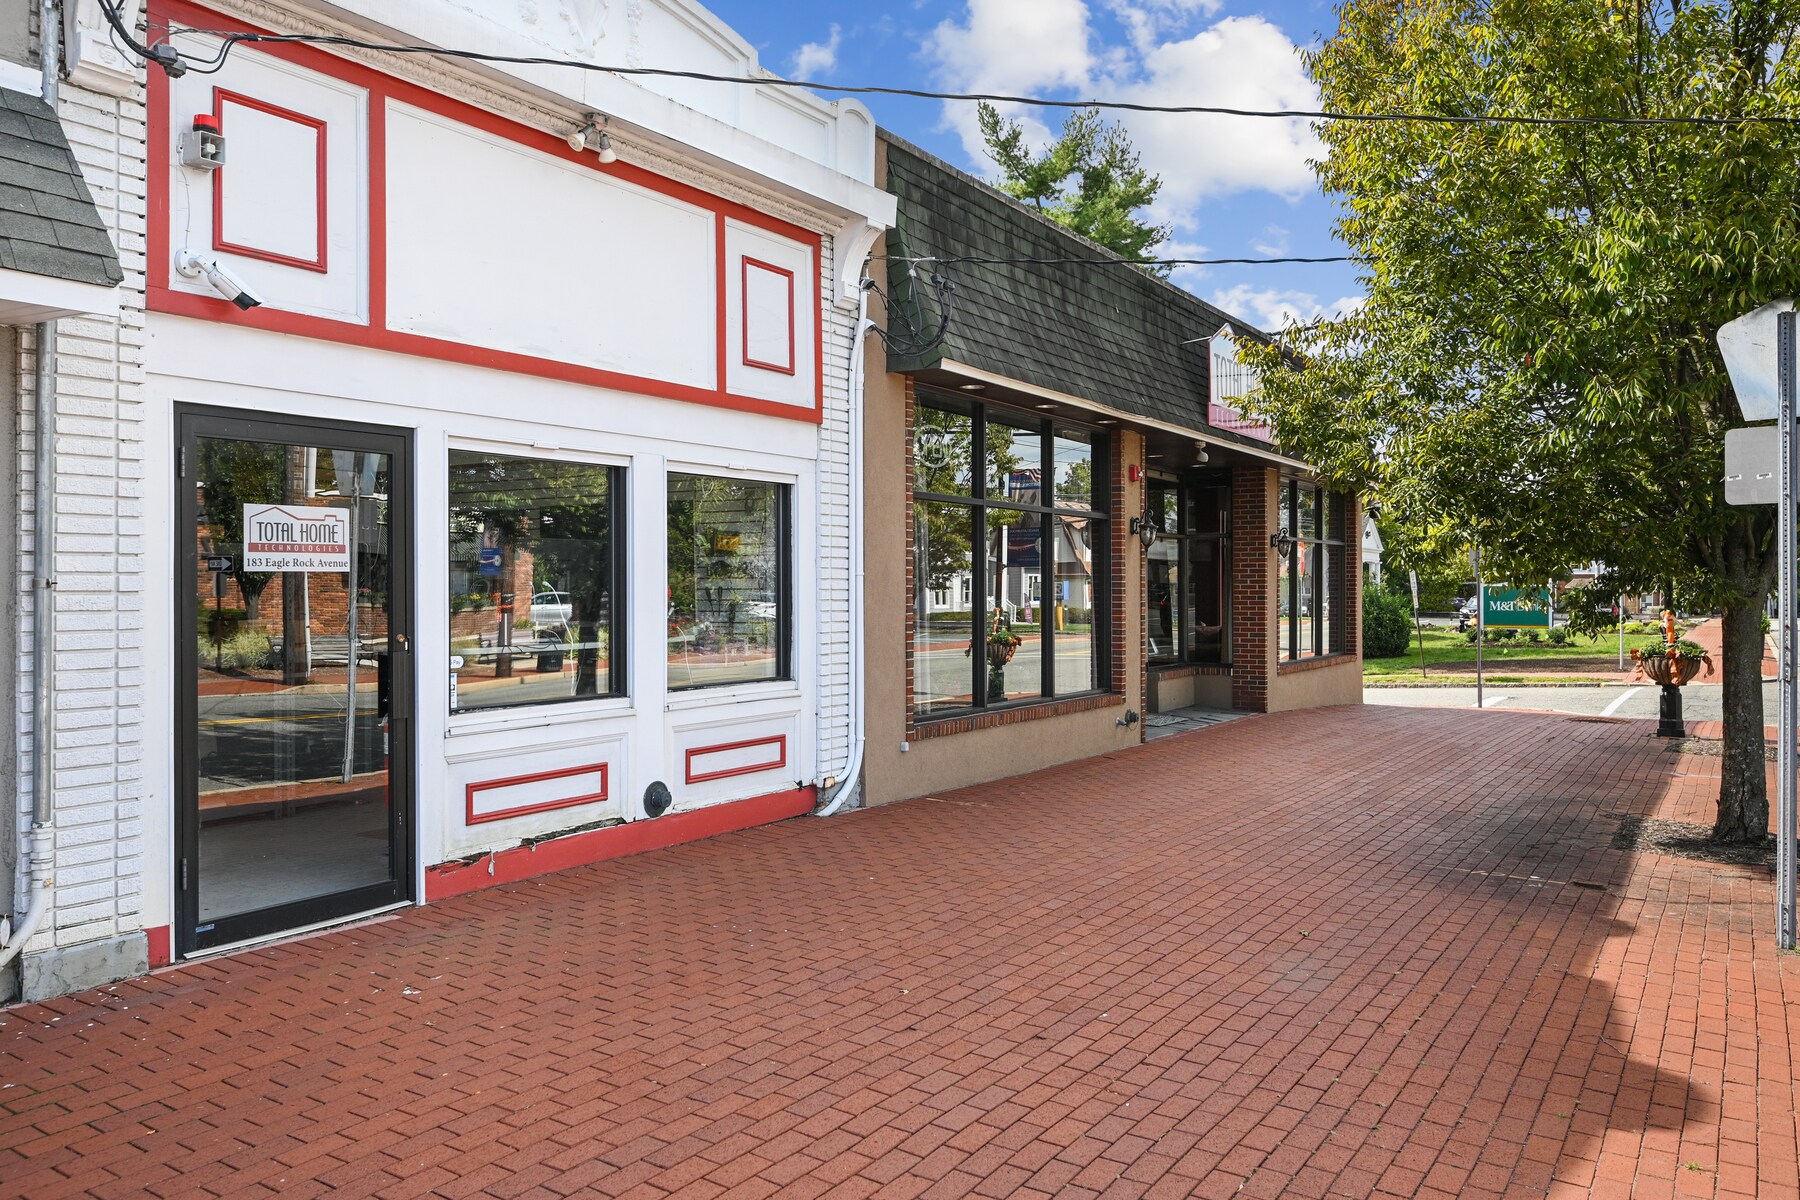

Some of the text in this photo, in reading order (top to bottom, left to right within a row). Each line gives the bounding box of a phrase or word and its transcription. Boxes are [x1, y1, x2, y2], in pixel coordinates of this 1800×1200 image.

[256, 521, 339, 544] TOTAL HOME
[257, 543, 340, 553] TECHNOLOGIES
[246, 557, 348, 569] 183 Eagle Rock Avenue
[1489, 600, 1542, 612] M&T Bnk
